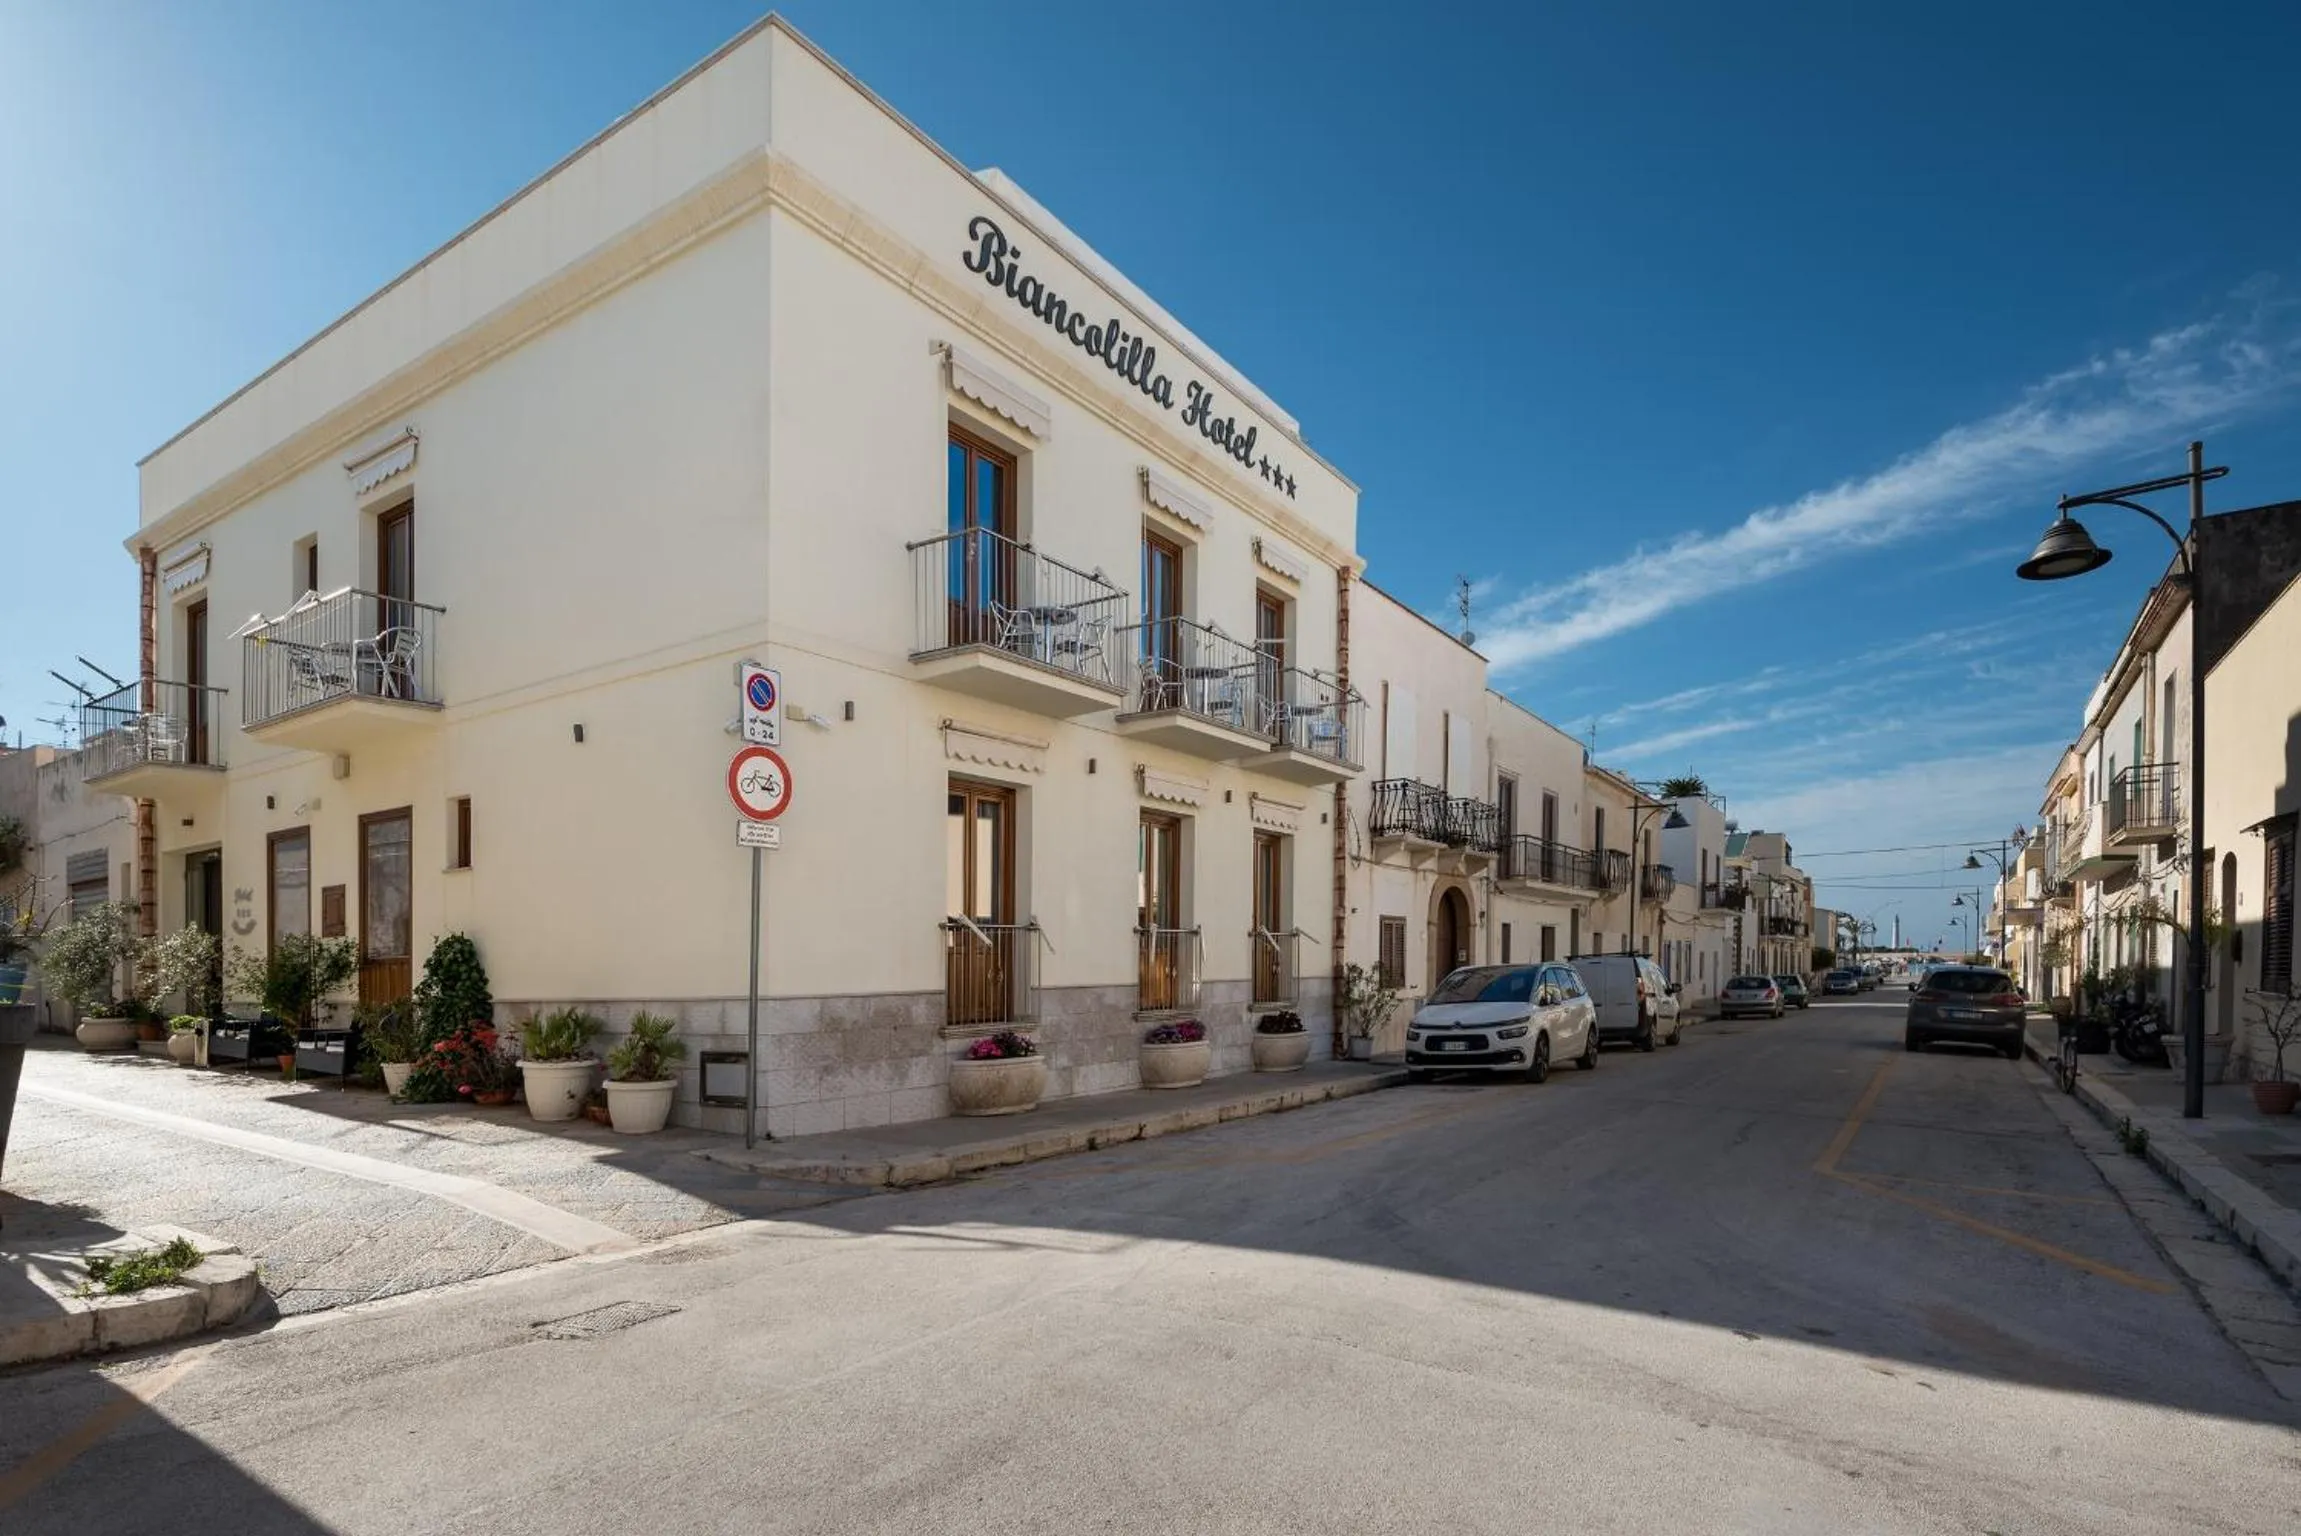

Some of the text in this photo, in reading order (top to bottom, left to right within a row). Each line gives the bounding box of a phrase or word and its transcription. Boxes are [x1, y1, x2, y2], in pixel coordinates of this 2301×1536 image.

[963, 216, 1257, 469] Biancolilla Hotel
[762, 729, 774, 740] 24
